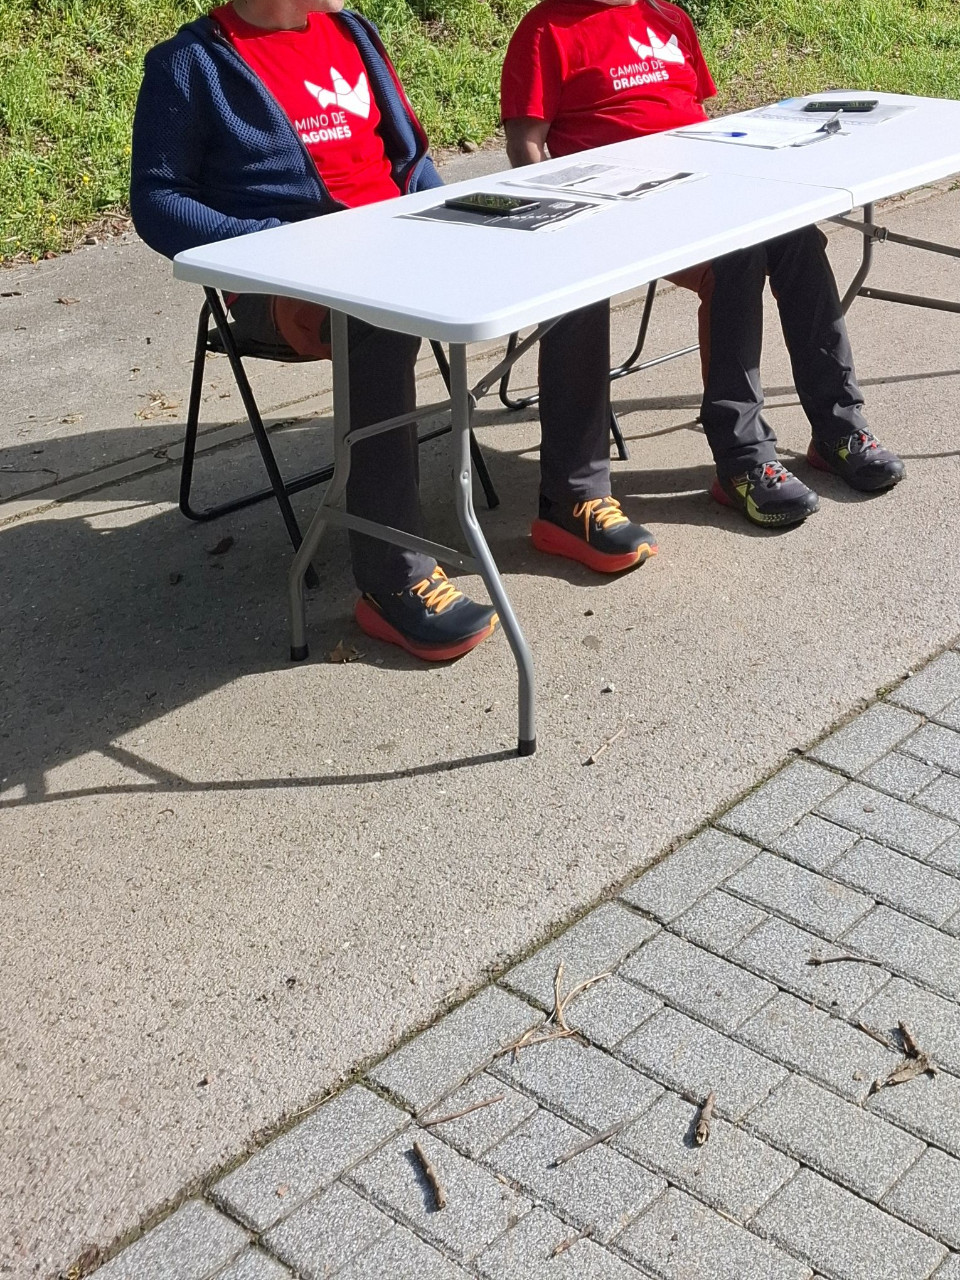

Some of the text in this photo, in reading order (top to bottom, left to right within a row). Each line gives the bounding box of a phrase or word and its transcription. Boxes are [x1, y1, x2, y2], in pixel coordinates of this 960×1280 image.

[609, 59, 666, 78] CAMINO DE
[613, 70, 670, 91] DRAGONES
[295, 111, 348, 132] MINO DE
[302, 125, 352, 144] AGONES
